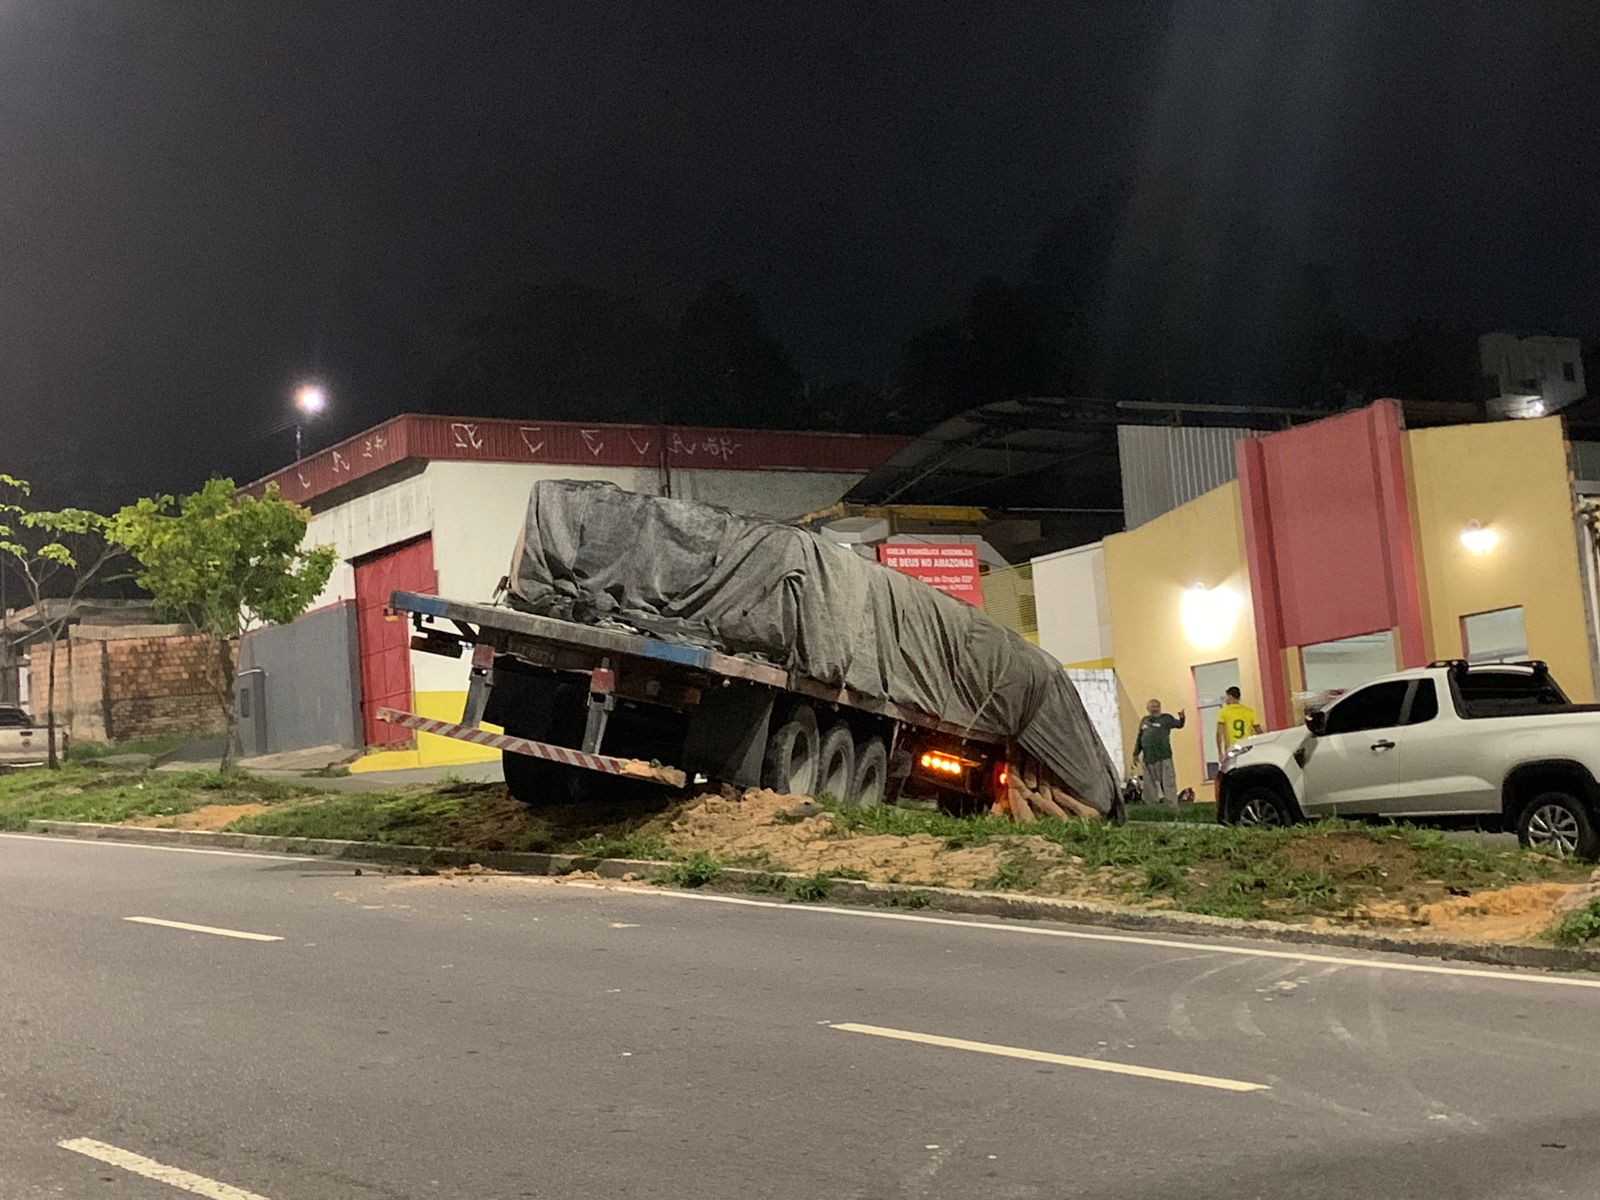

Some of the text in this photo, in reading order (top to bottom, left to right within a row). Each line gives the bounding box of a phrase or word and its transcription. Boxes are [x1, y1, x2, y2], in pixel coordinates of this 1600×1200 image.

[887, 557, 974, 568] DE DEUS NO AMAZONAS
[1233, 719, 1245, 739] 9
